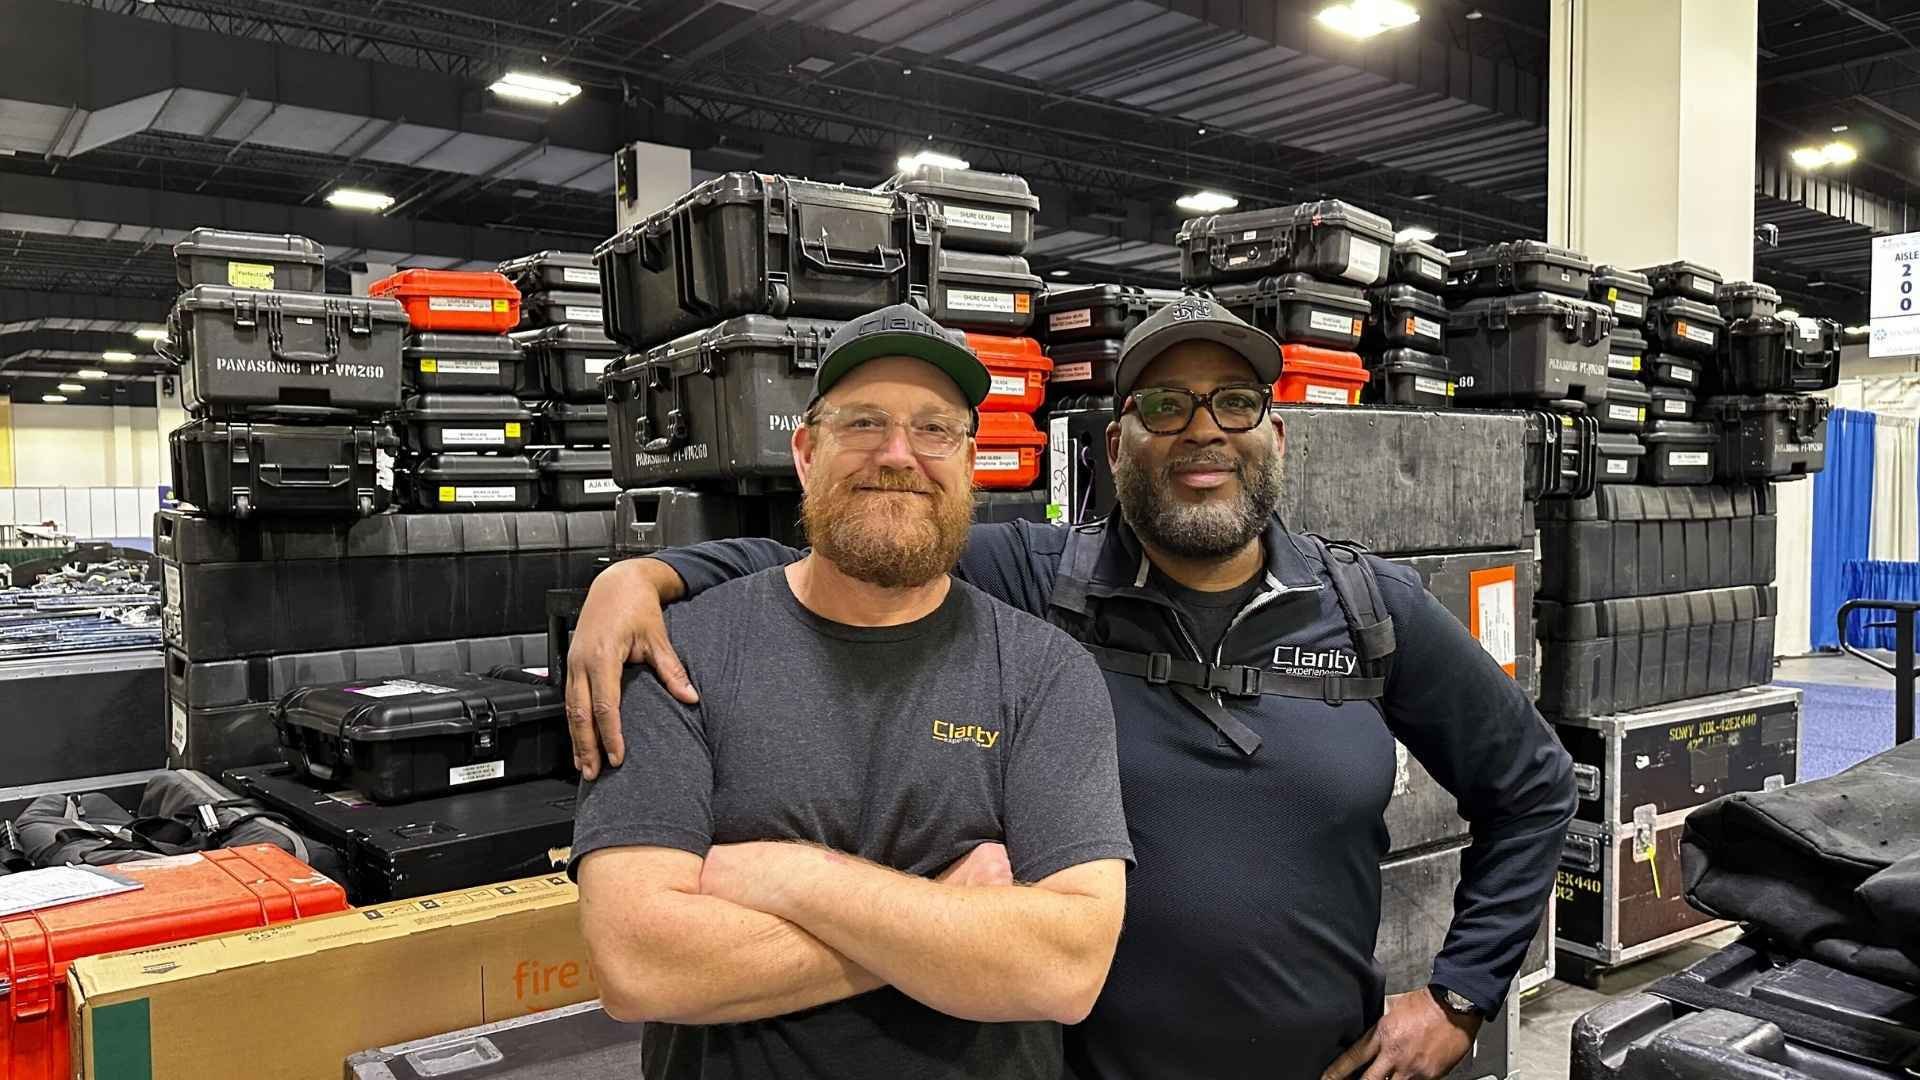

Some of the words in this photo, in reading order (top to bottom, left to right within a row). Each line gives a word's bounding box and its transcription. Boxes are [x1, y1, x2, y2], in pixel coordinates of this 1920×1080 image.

[1895, 251, 1920, 262] AISLE
[216, 357, 301, 375] PANASONIC
[310, 362, 385, 379] PT-VM260
[1272, 646, 1358, 676] Clarity
[1668, 724, 1695, 741] SONY
[1556, 870, 1602, 894] EX440
[512, 959, 579, 1001] fire
